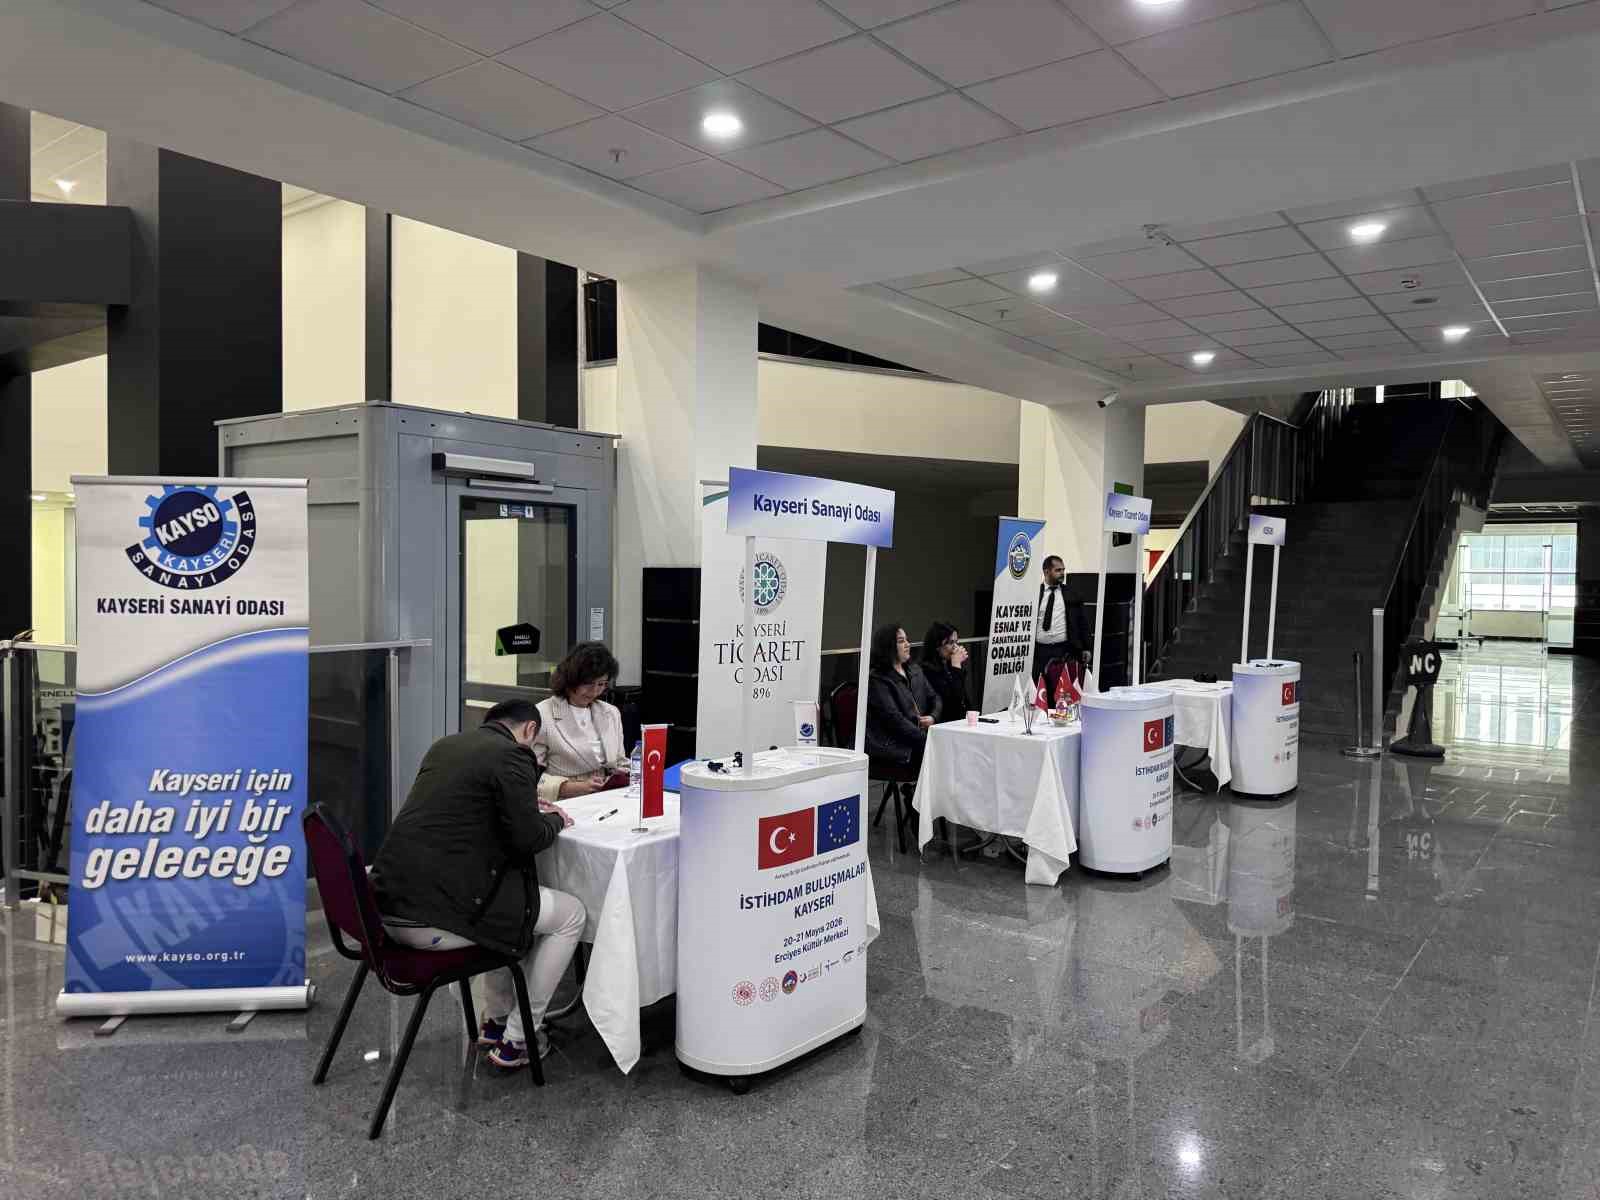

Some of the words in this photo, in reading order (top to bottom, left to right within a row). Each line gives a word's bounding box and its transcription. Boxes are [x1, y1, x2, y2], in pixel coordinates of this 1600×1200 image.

[753, 493, 808, 517] Kayseri
[811, 499, 852, 522] Sanayi
[855, 504, 880, 523] Odası
[155, 502, 220, 546] KAYSO
[131, 551, 217, 589] SANAYI
[228, 500, 255, 570] ODASI
[163, 530, 236, 571] KAYSERI
[97, 595, 165, 615] KAYSERİ
[170, 595, 232, 616] SANAYİ
[236, 599, 285, 616] ODASI
[996, 601, 1032, 618] KAYSERİ
[736, 620, 786, 637] KYSERİ
[994, 621, 1020, 634] ESNAF
[1022, 621, 1031, 632] VE
[991, 644, 1030, 660] ODALARI
[993, 657, 1025, 676] BİRLİĞİ
[753, 687, 771, 700] 896
[149, 769, 243, 796] Kayseri
[245, 769, 293, 797] için
[85, 800, 176, 835] daha
[184, 799, 234, 839] iyi
[238, 798, 293, 835] bir
[82, 834, 293, 889] geleceğe
[740, 884, 803, 910] İSTİHDAM
[794, 890, 834, 919] KAYSERİ
[775, 947, 802, 963] Erciyes
[824, 926, 849, 945] Merkezi
[783, 932, 804, 948] 20-21
[825, 916, 844, 930] 2026
[125, 950, 246, 964] www.kayso.org.tr
